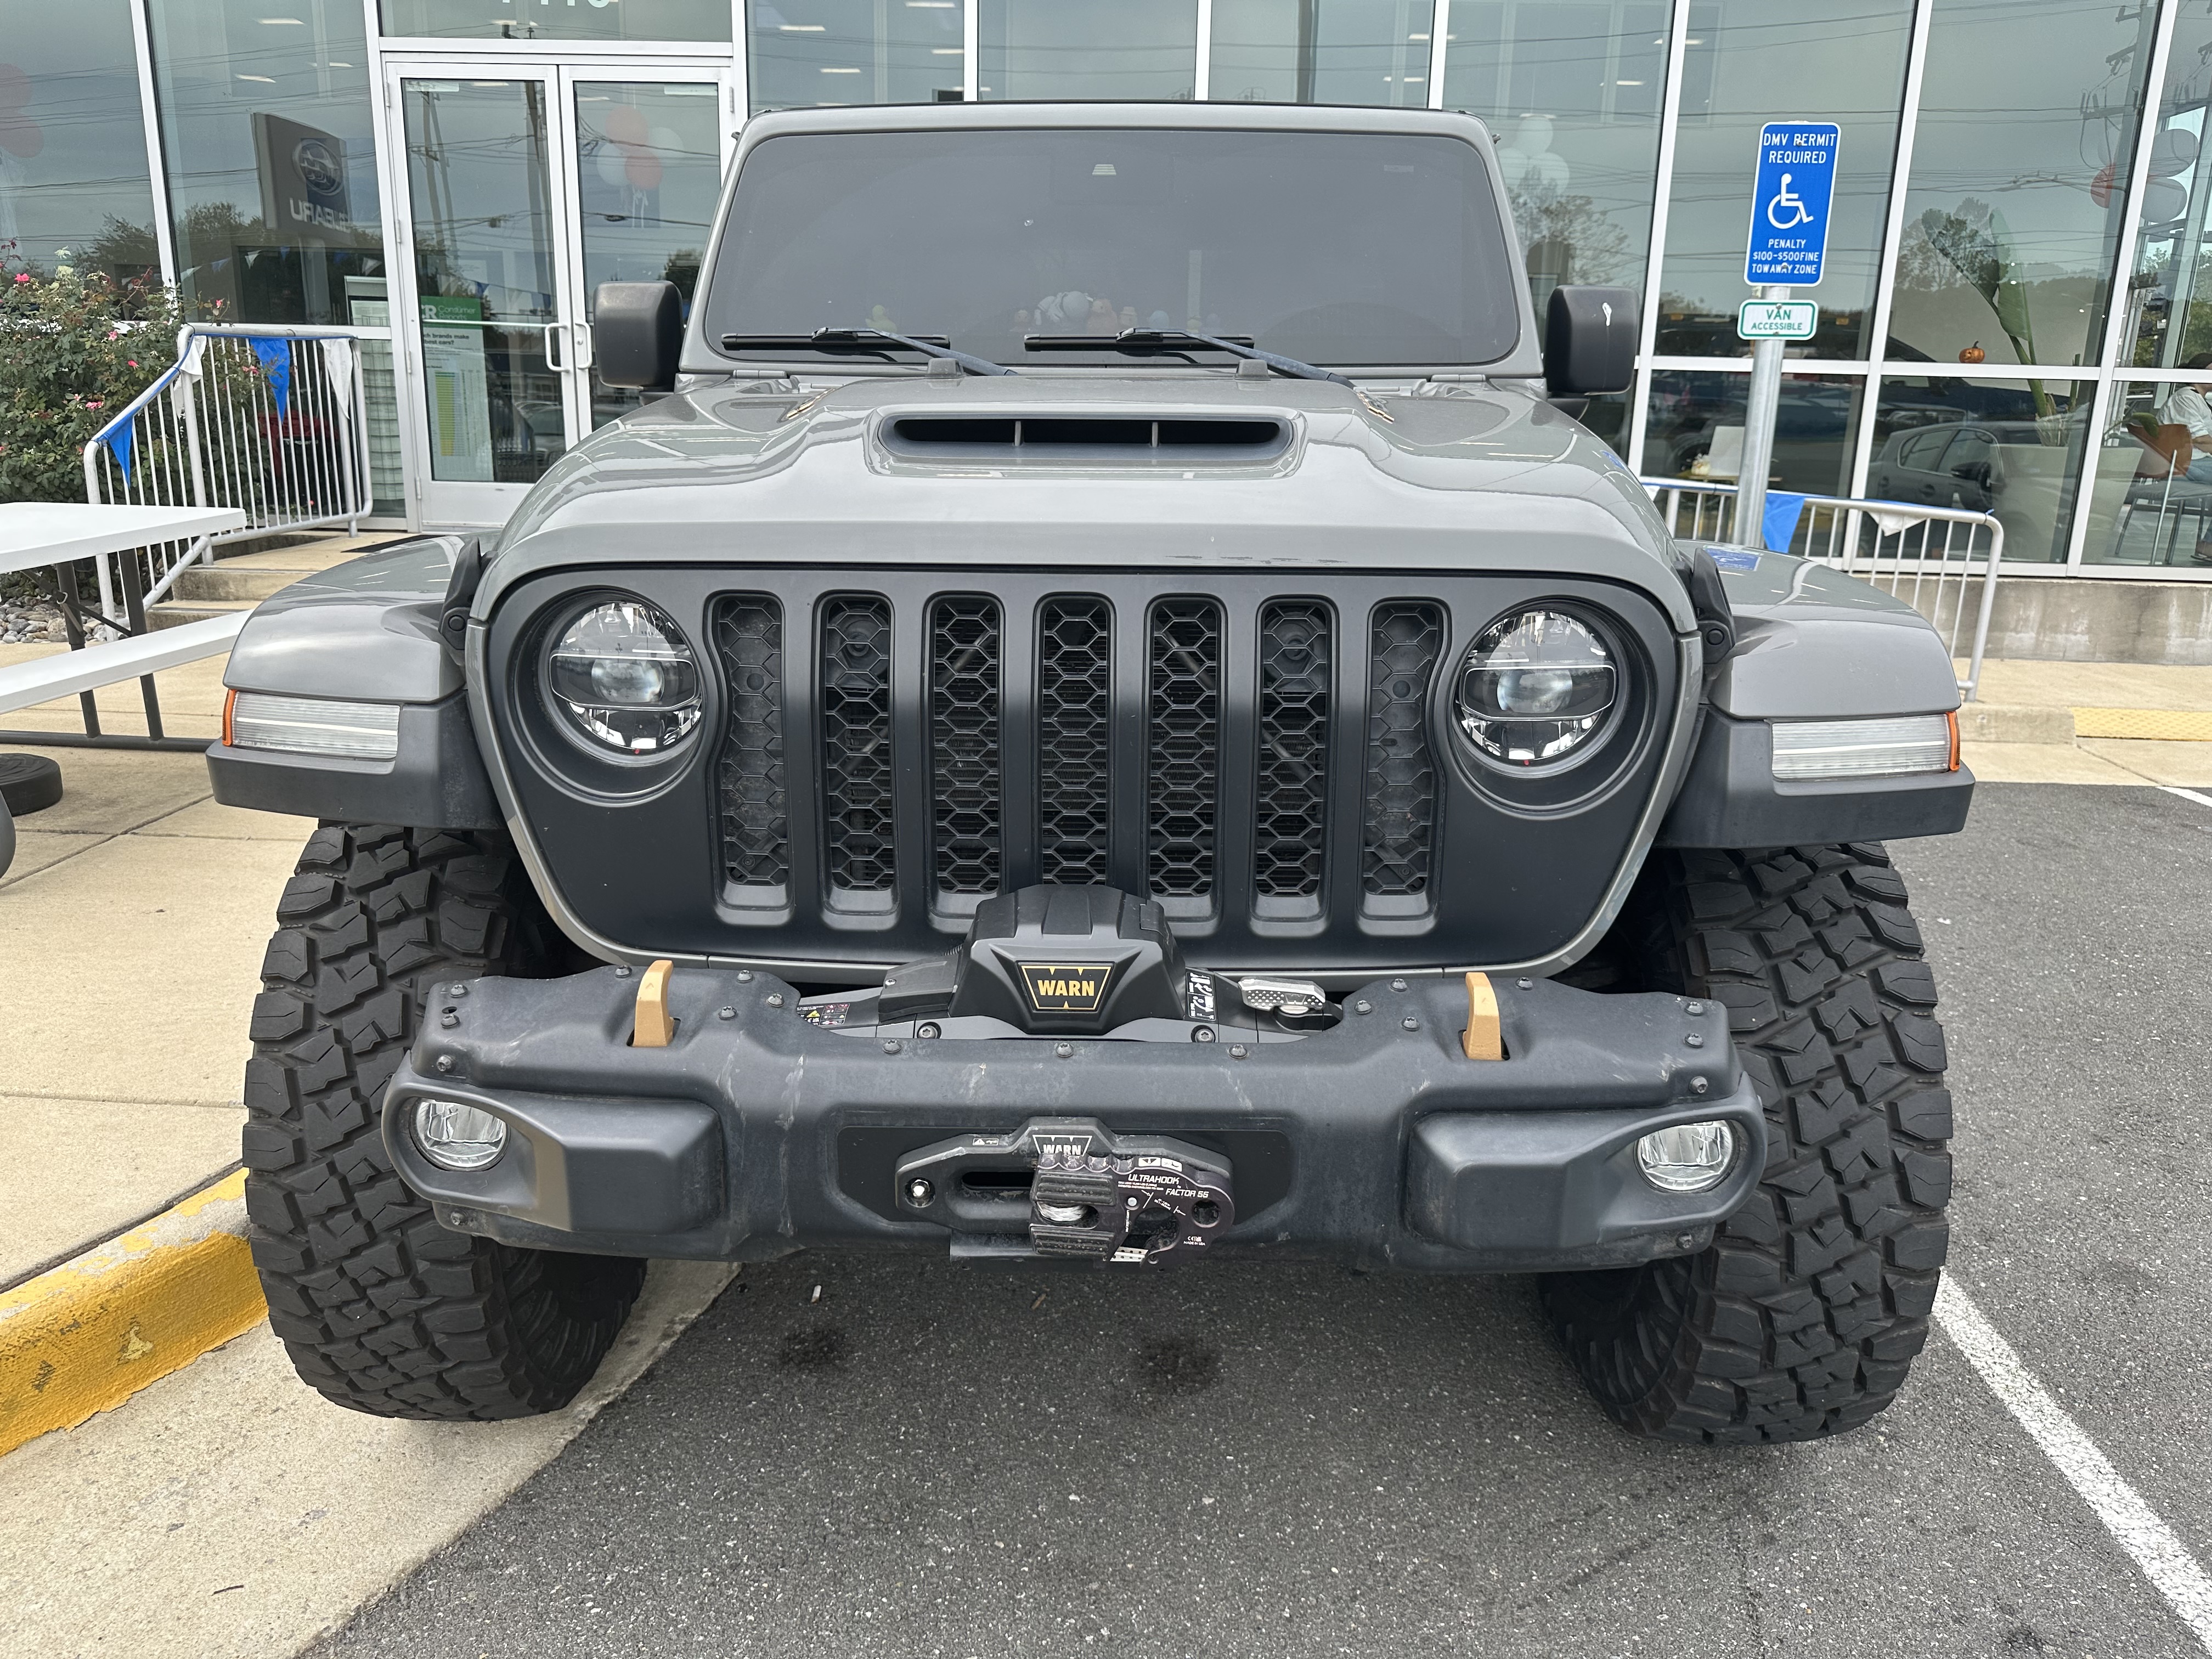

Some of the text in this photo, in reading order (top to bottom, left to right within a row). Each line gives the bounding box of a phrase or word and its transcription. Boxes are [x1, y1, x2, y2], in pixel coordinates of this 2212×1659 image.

[1763, 133, 1836, 146] DMV PERMIT
[1769, 151, 1826, 163] REQUIRED
[1768, 239, 1806, 249] PENALTY
[1794, 264, 1817, 274] ZONE
[439, 306, 476, 314] Consumer
[1766, 309, 1791, 320] VAN
[1751, 322, 1803, 330] ACCESSIBLE
[1037, 980, 1094, 996] WARN
[1043, 1144, 1081, 1155] WARN
[1128, 1173, 1180, 1184] ULTRAHOOK
[1165, 1188, 1196, 1198] FACTOR
